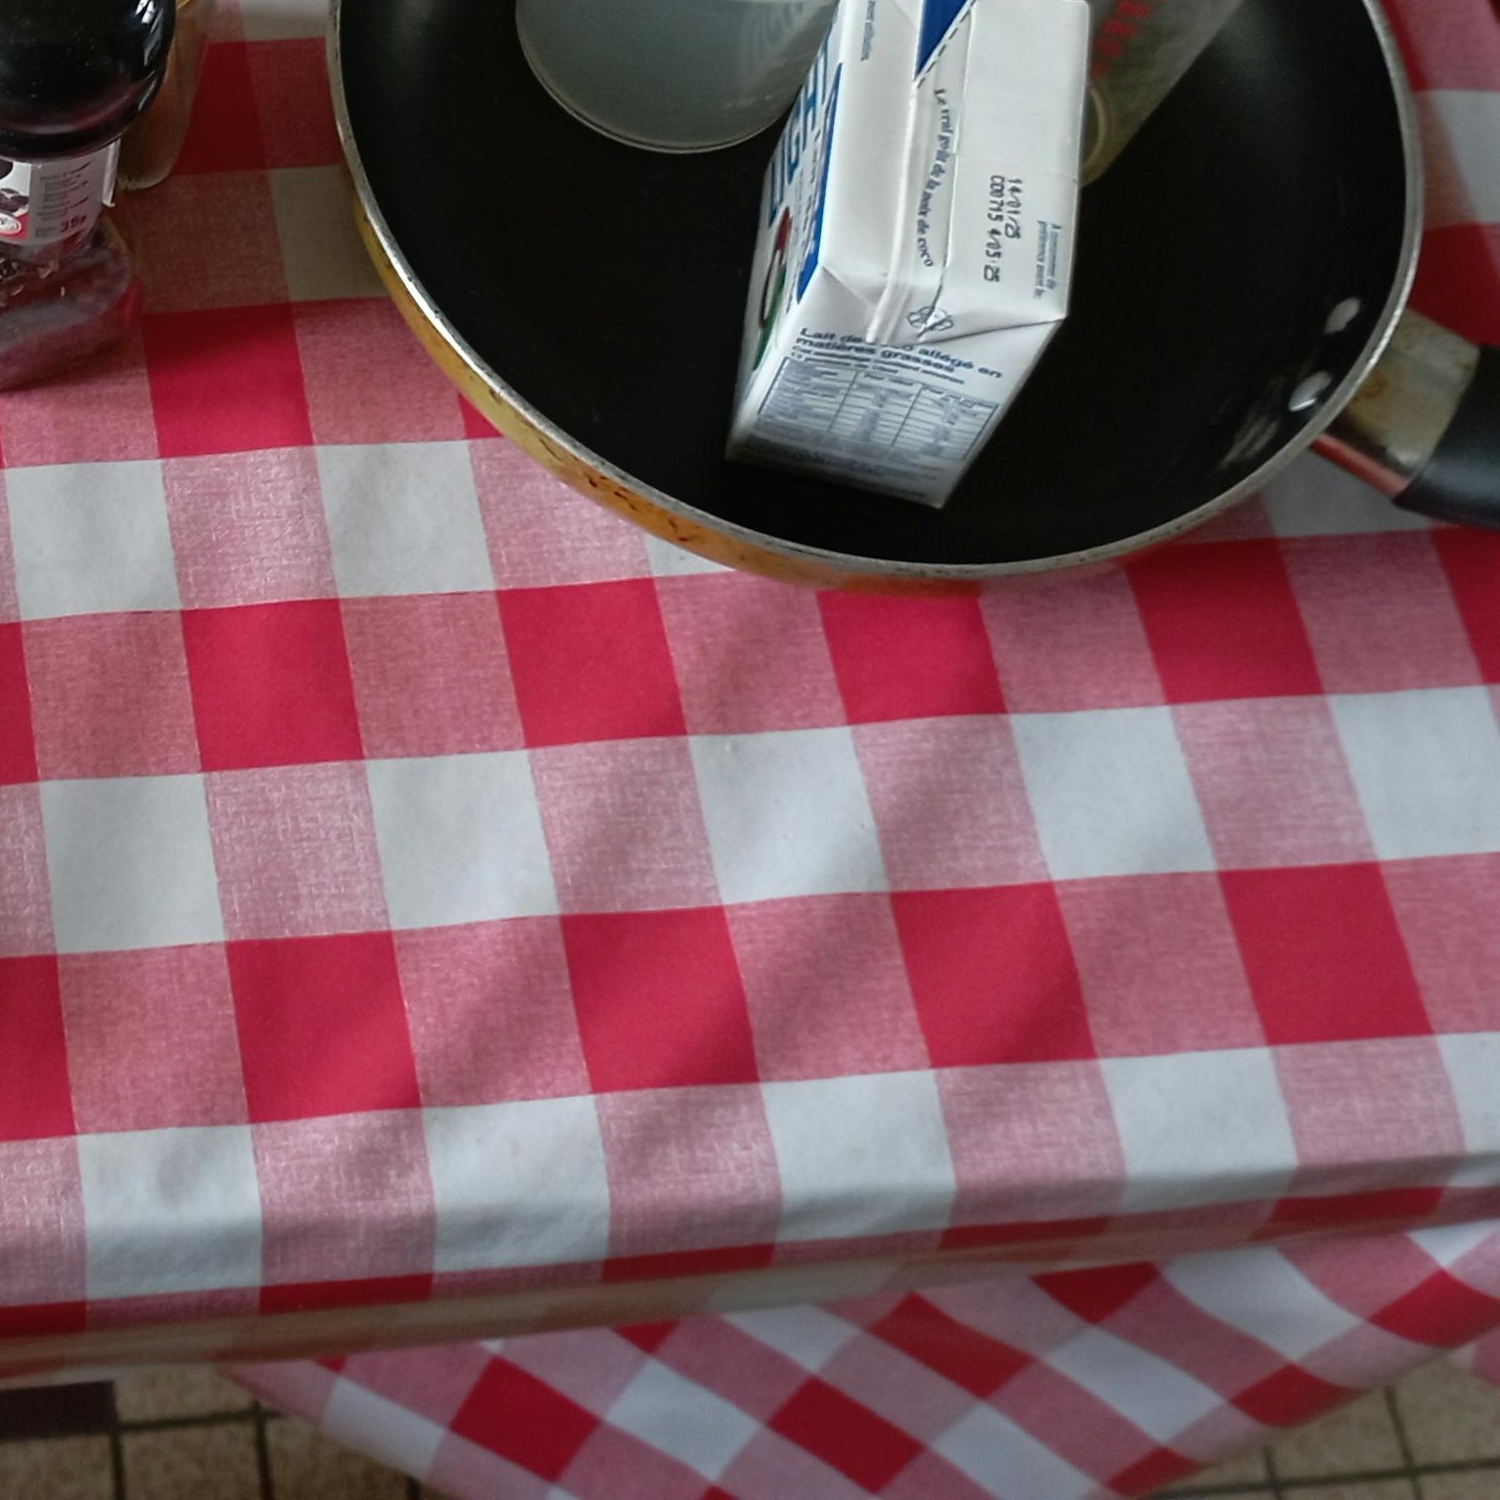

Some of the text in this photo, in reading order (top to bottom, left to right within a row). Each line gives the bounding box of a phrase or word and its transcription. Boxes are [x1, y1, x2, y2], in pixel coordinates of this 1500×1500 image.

[917, 235, 934, 268] coco
[799, 327, 837, 342] Lait
[917, 346, 975, 370] allégé
